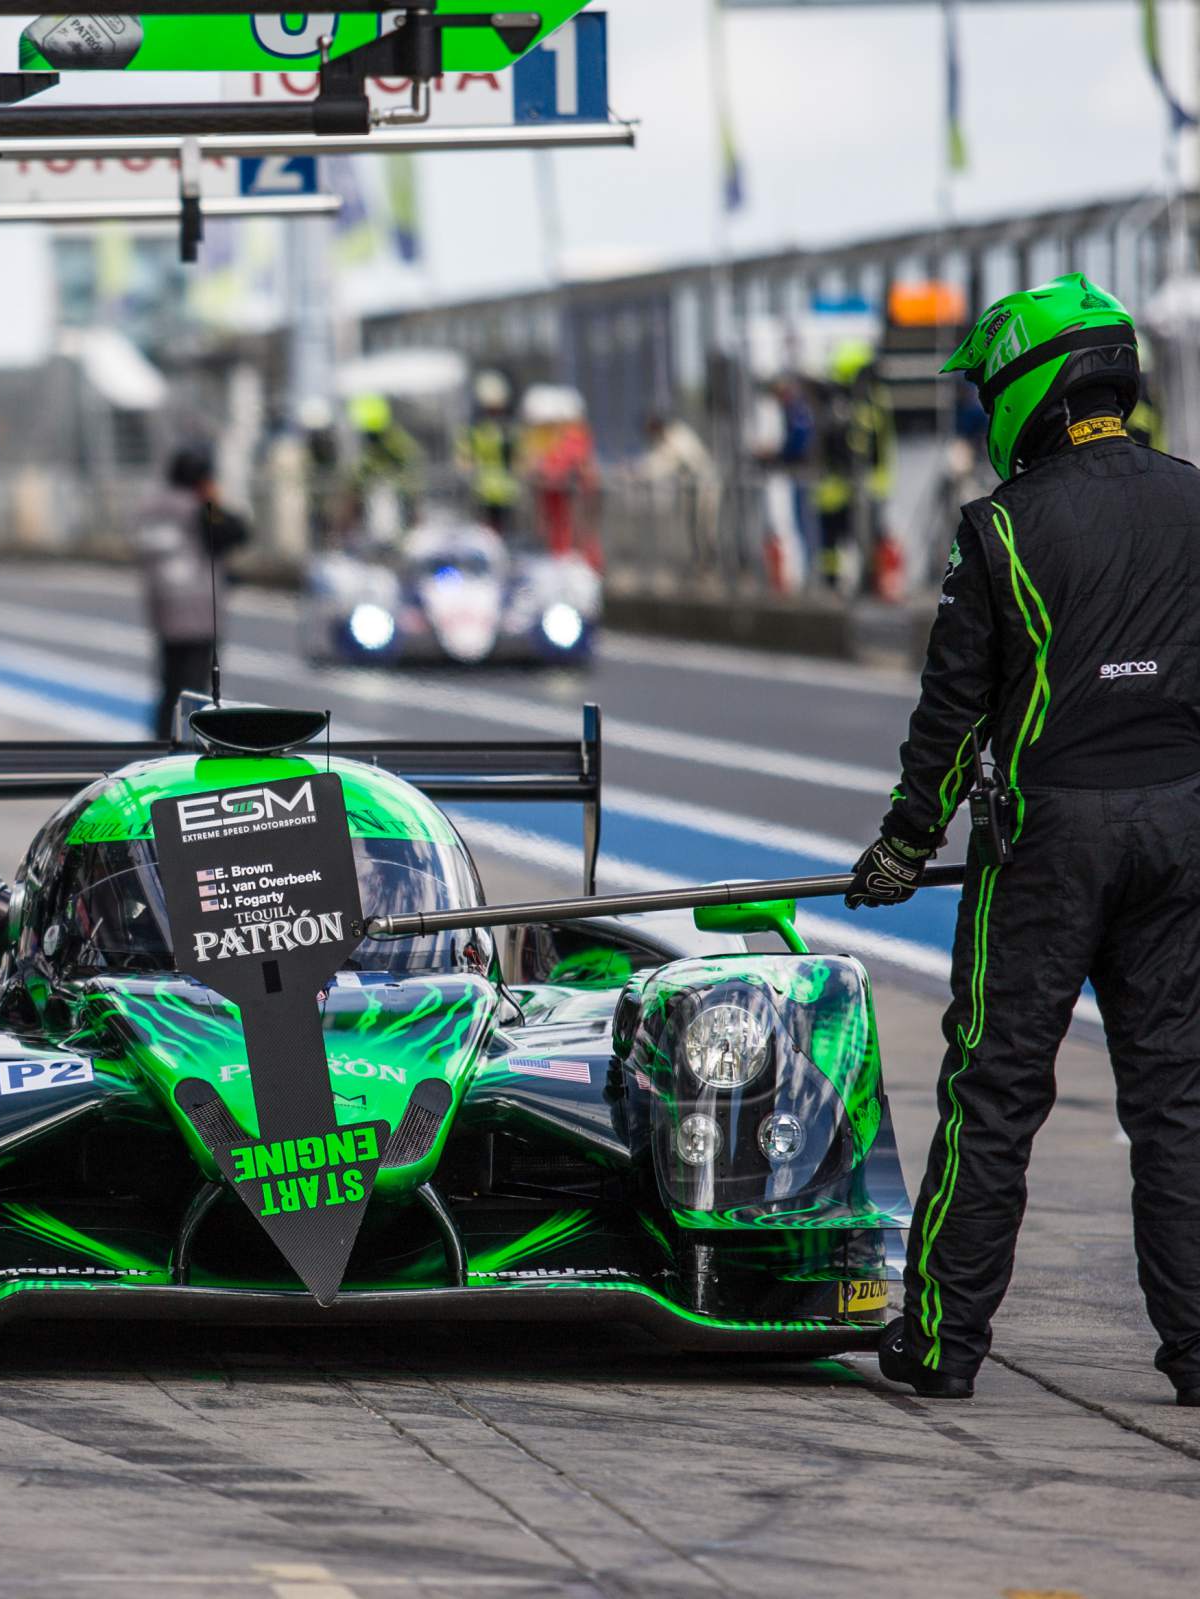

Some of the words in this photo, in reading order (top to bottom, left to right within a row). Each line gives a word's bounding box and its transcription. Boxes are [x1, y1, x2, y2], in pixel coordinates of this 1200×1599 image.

[1099, 660, 1158, 680] sparco
[177, 781, 315, 832] ESM
[182, 829, 221, 843] EXTREME
[223, 825, 250, 837] SPEED
[253, 815, 317, 832] MOTORSPORTS
[214, 867, 229, 880] E.
[231, 863, 274, 878] Brown
[217, 882, 230, 895] J.
[233, 880, 257, 892] van
[259, 870, 322, 888] Overbeek
[220, 897, 232, 910] J.
[235, 891, 285, 909] Fogarty
[234, 905, 297, 925] TEQUILA
[193, 909, 344, 963] PATRÓN
[8, 1060, 86, 1089] P2
[231, 1127, 380, 1184] ENGINE
[260, 1169, 365, 1216] START
